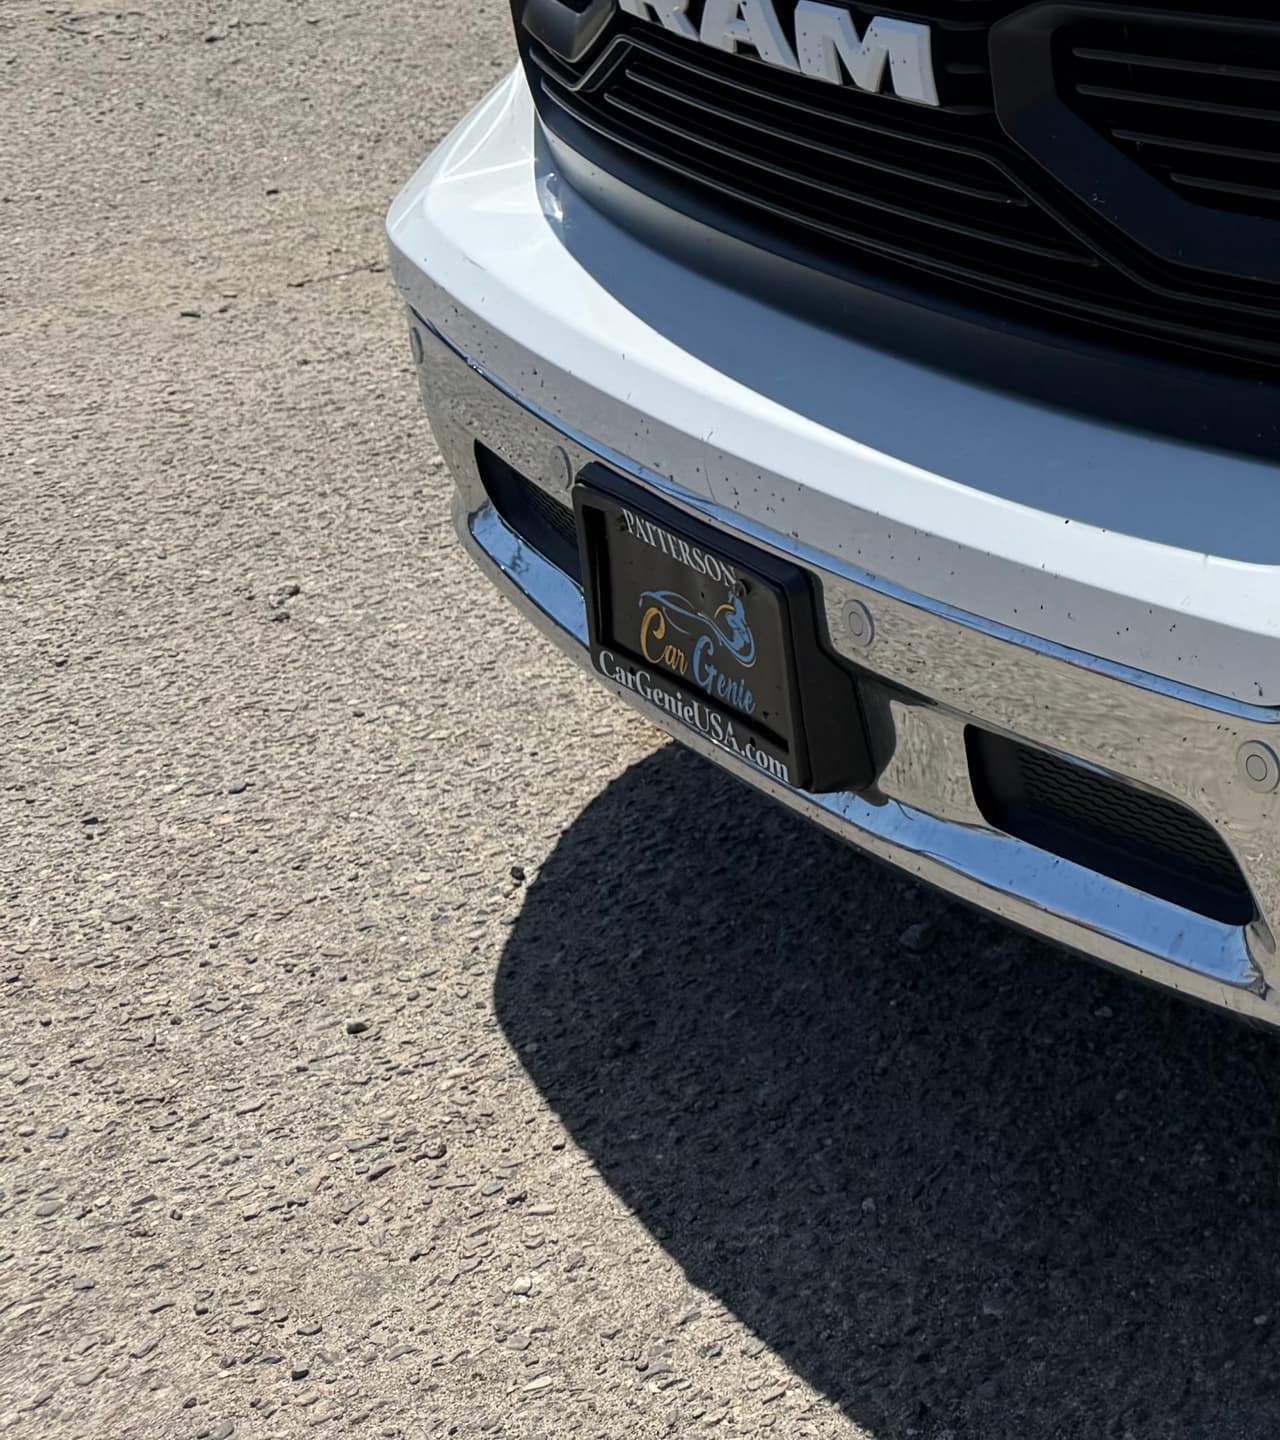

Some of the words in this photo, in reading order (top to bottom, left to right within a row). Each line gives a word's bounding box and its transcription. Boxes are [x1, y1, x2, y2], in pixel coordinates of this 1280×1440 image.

[622, 509, 736, 587] PATTERSON
[640, 607, 688, 676] Car
[693, 635, 756, 714] Genie
[600, 650, 790, 783] CarGenieUSA.com
